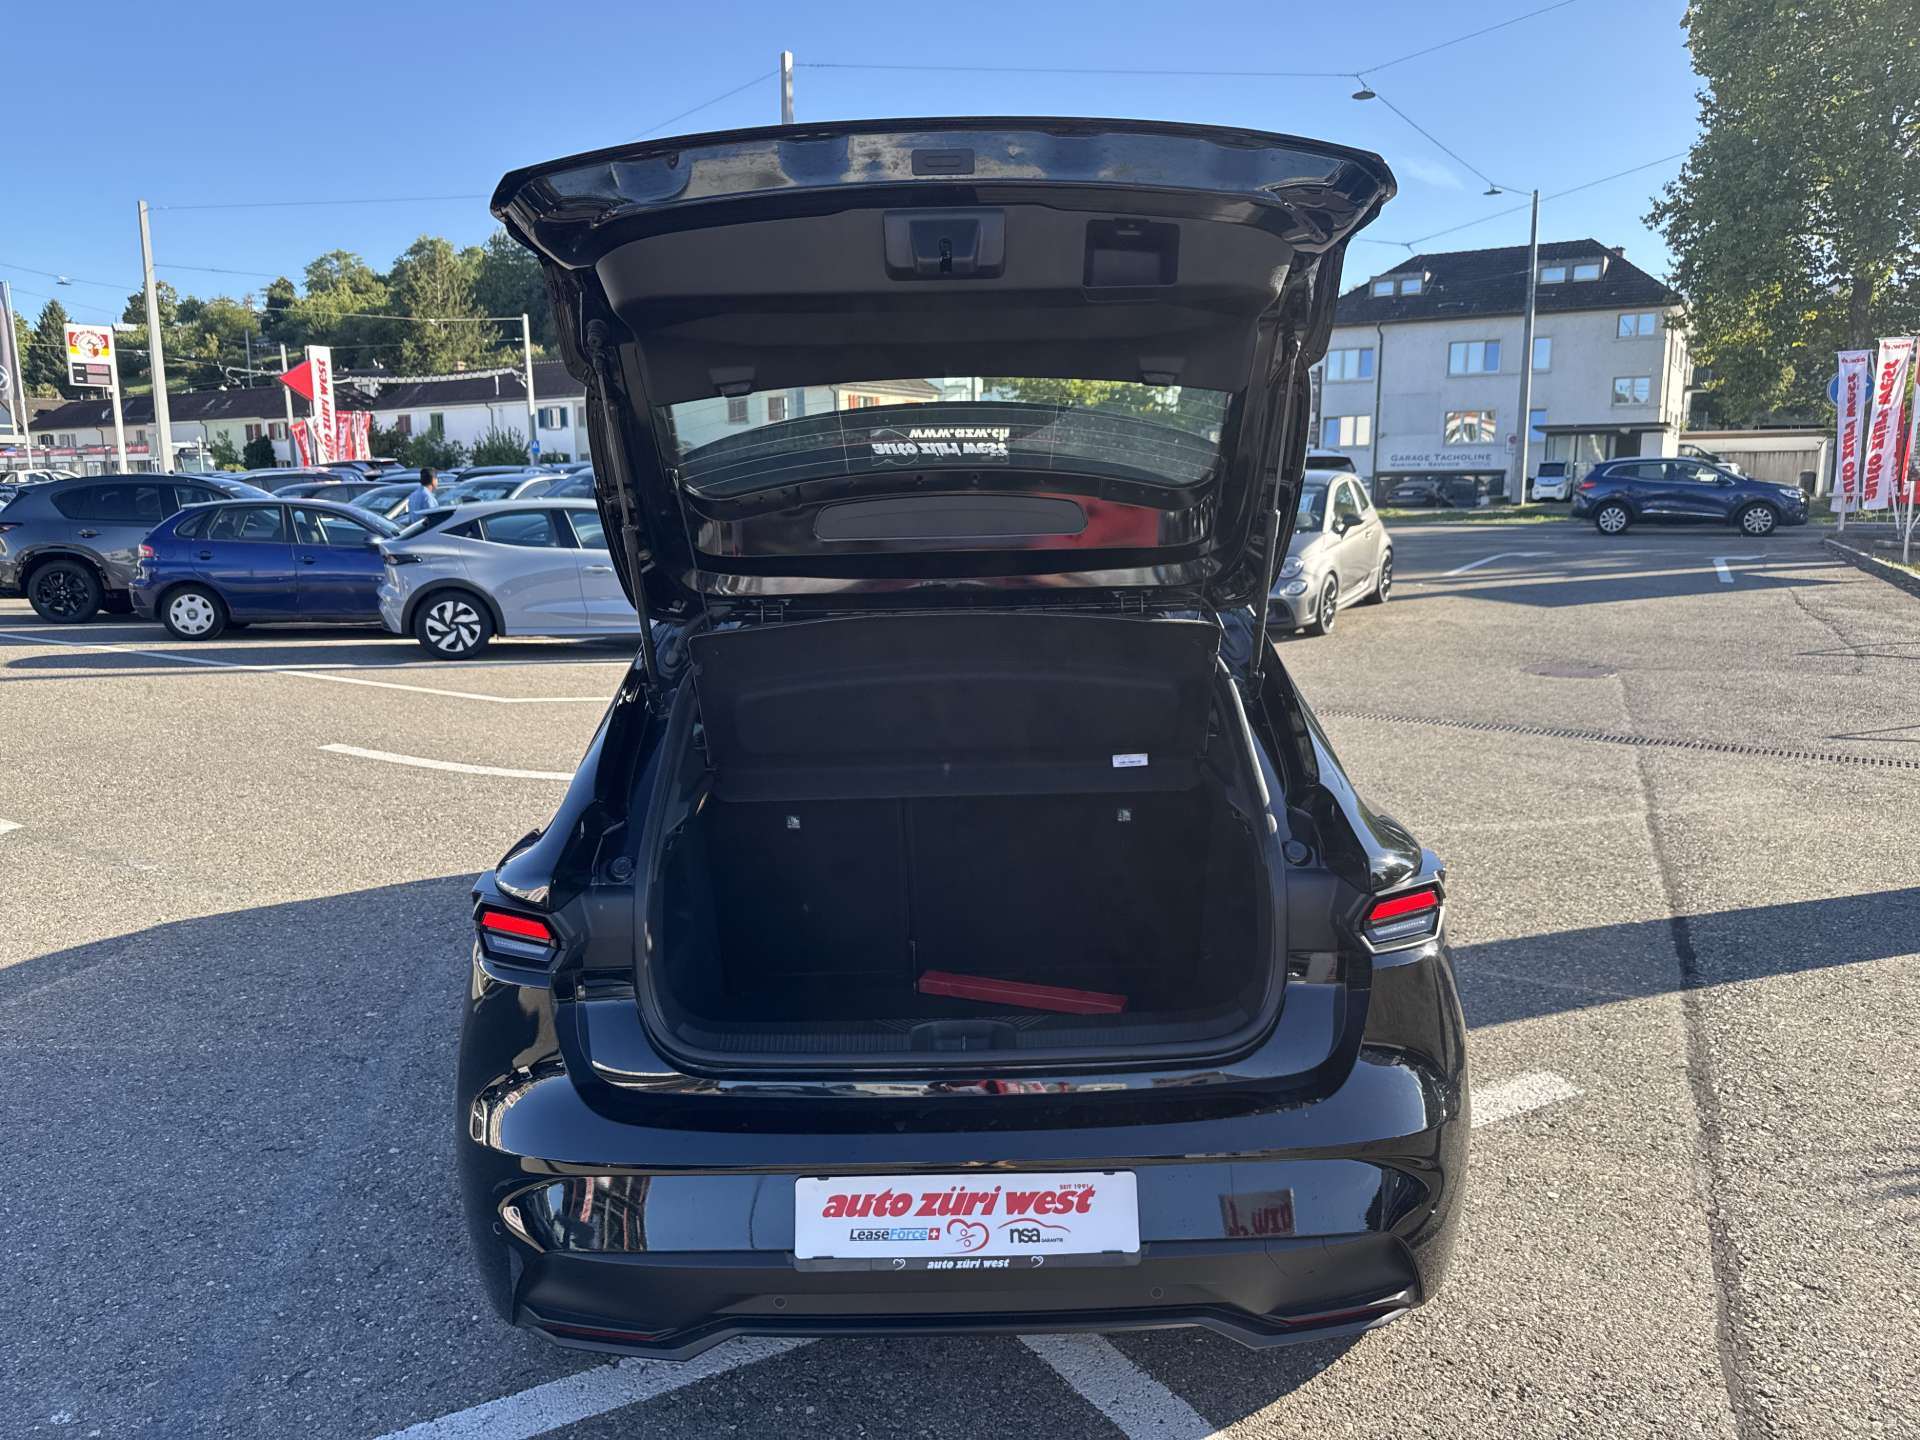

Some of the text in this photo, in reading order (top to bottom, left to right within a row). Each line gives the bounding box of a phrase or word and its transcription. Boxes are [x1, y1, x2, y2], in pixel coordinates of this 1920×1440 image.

[317, 358, 328, 395] west
[822, 1184, 1096, 1218] auto züri west
[849, 1228, 928, 1241] LeaseForce
[1009, 1228, 1041, 1243] nsa
[927, 1258, 1010, 1270] auto züri west
